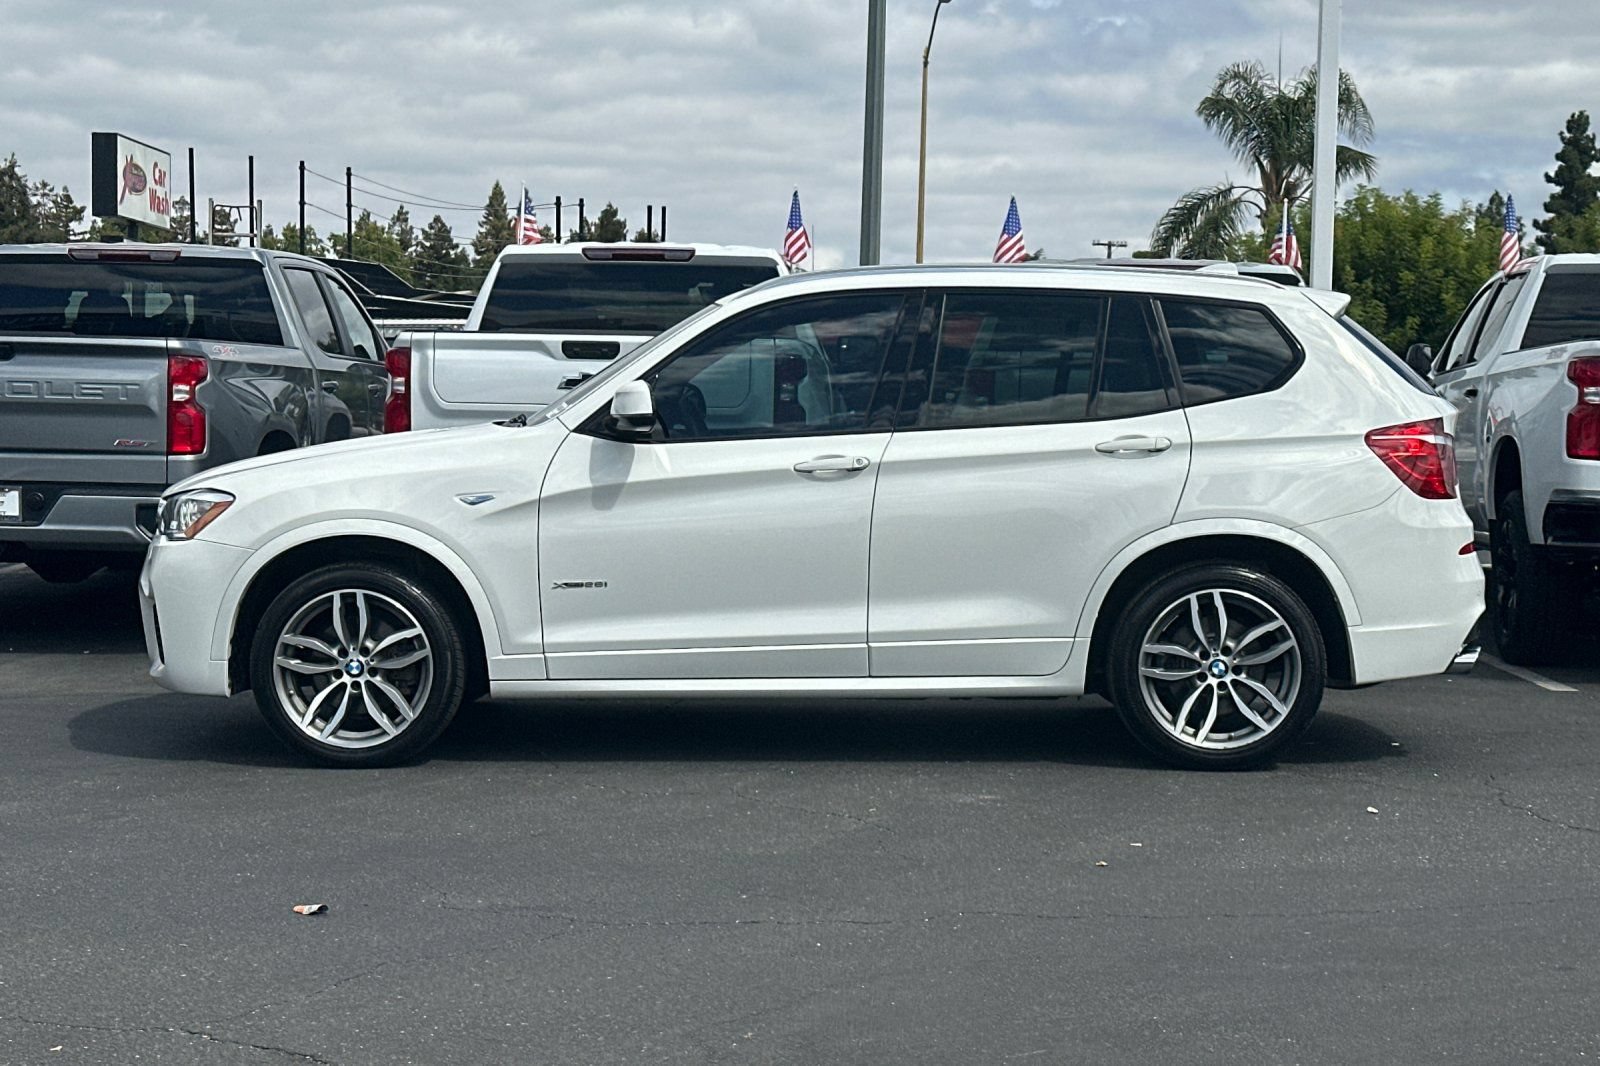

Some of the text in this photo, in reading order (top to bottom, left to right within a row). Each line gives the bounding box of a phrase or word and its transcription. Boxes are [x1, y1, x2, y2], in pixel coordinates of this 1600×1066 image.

[153, 161, 167, 187] Car
[149, 187, 170, 216] Wash
[0, 380, 140, 400] OLET
